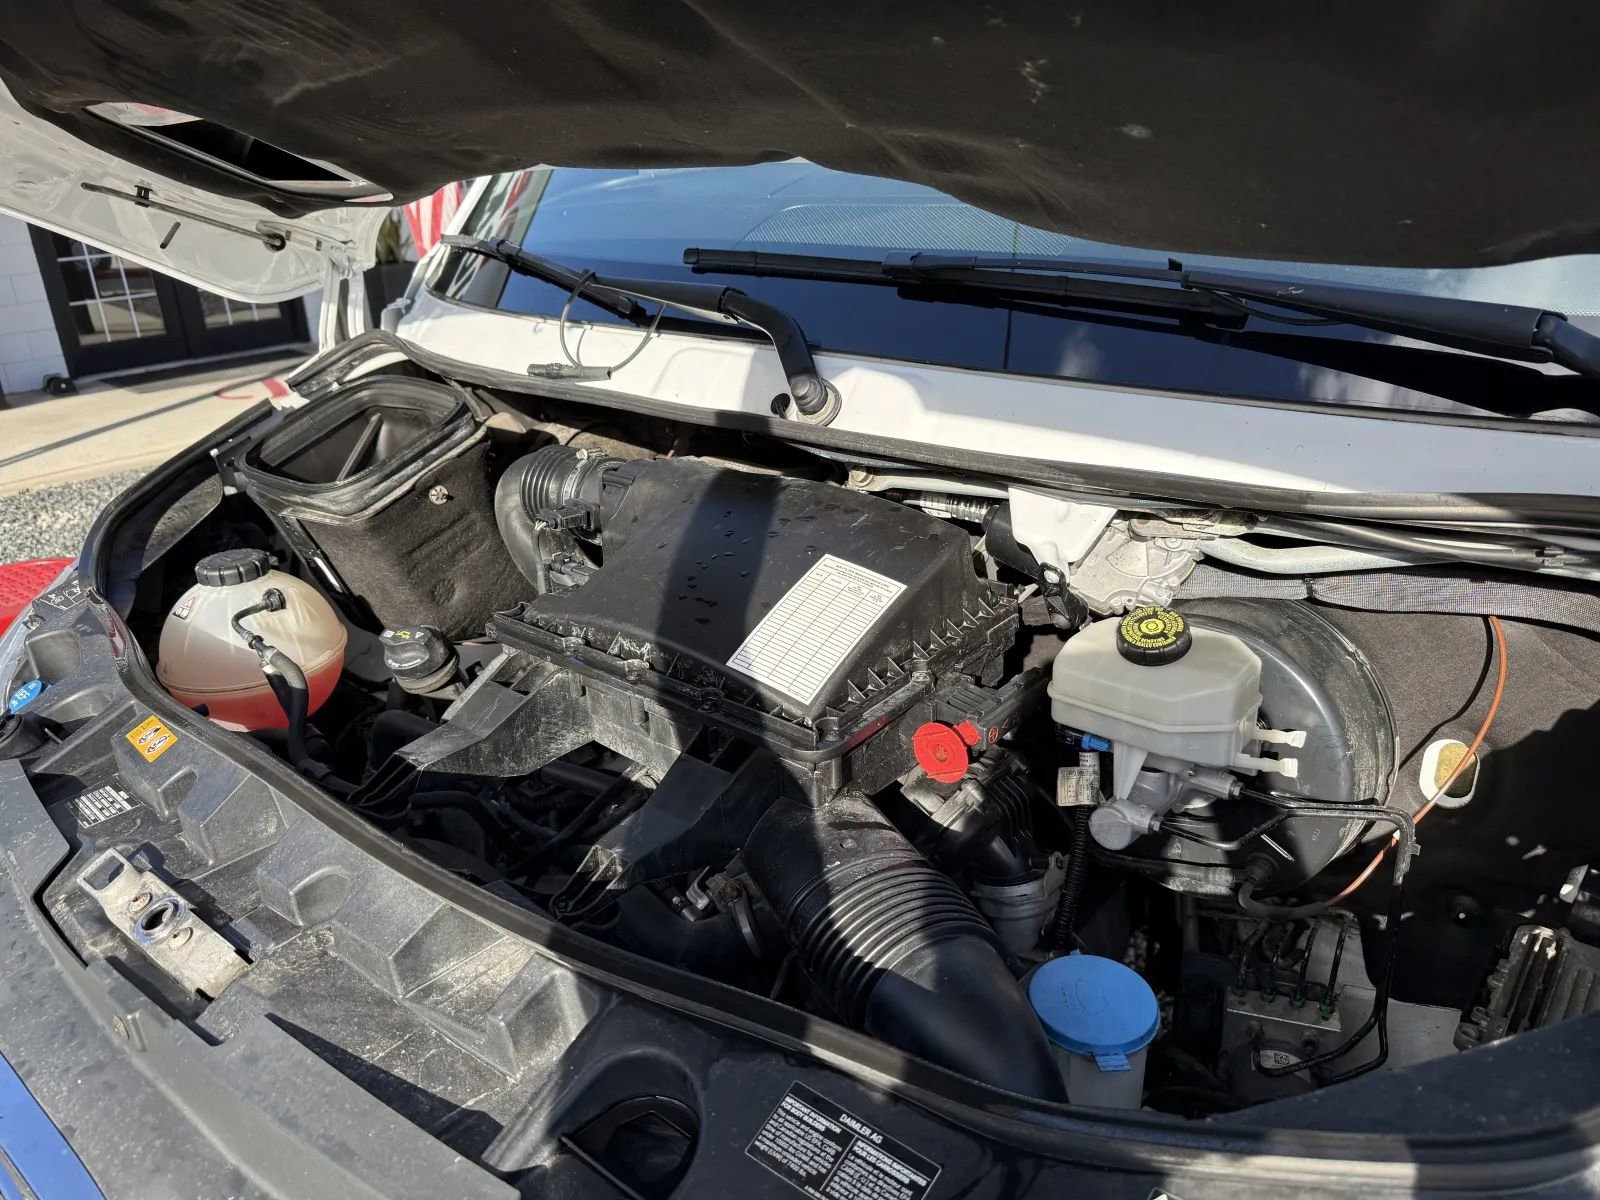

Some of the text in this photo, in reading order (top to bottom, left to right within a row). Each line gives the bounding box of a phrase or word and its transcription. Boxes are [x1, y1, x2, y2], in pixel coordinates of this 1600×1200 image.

[780, 1101, 825, 1131] FOR BODY BUILDERS
[784, 1096, 841, 1133] IMPORTANT INFORMATION
[839, 1113, 883, 1143] DAIMLER AG
[856, 1140, 927, 1186] INFORMATIONS IMPORTANTES
